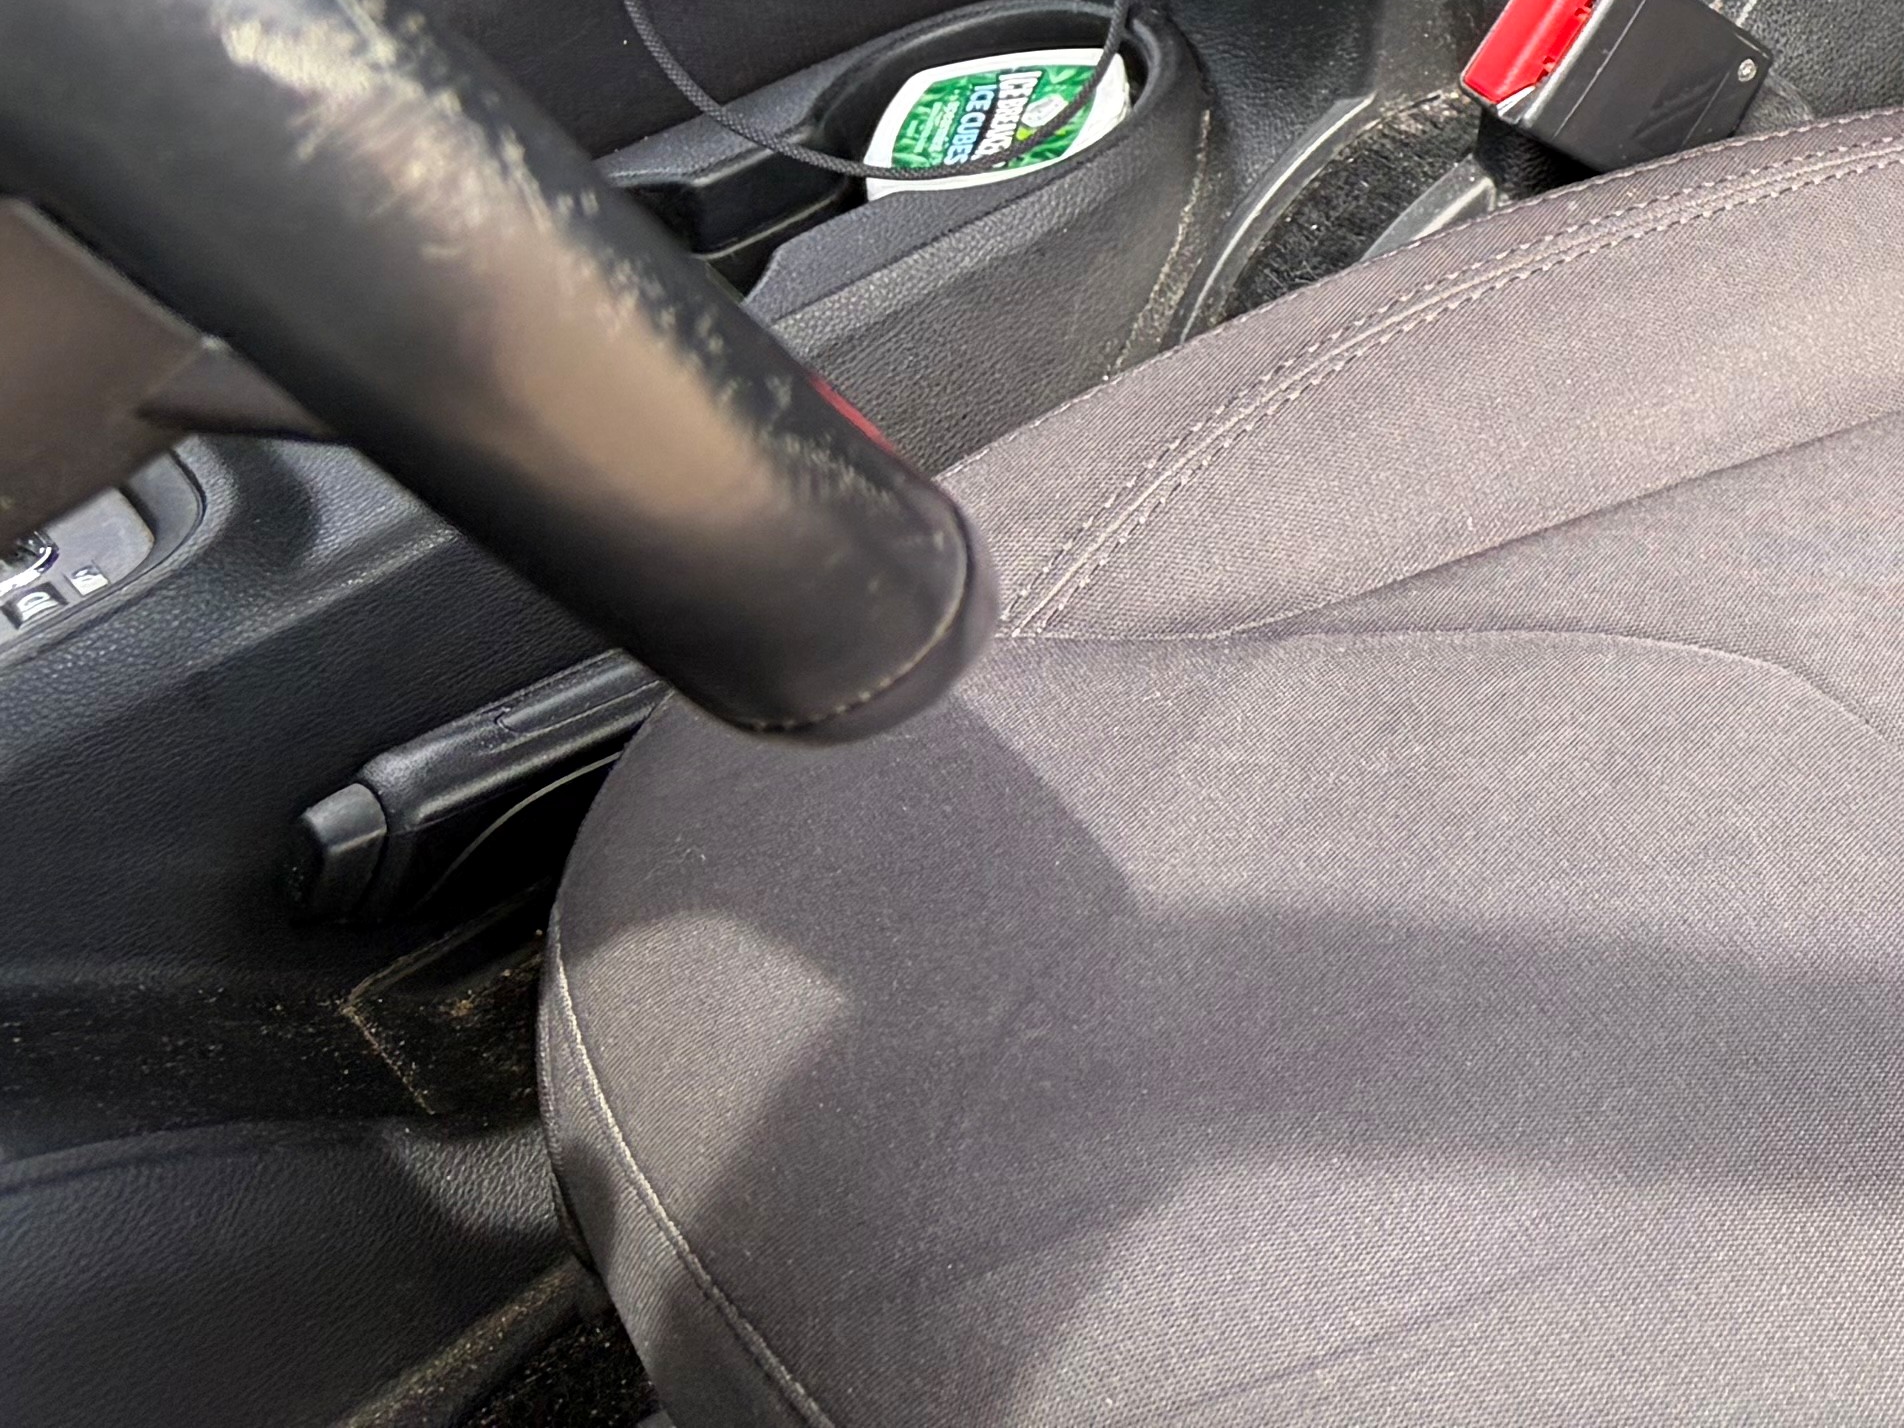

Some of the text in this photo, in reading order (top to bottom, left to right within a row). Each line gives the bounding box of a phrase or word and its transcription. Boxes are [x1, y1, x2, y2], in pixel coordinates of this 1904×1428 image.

[965, 84, 998, 112] ICE
[971, 71, 1042, 167] ICE BREAKE
[943, 111, 987, 166] CUBES
